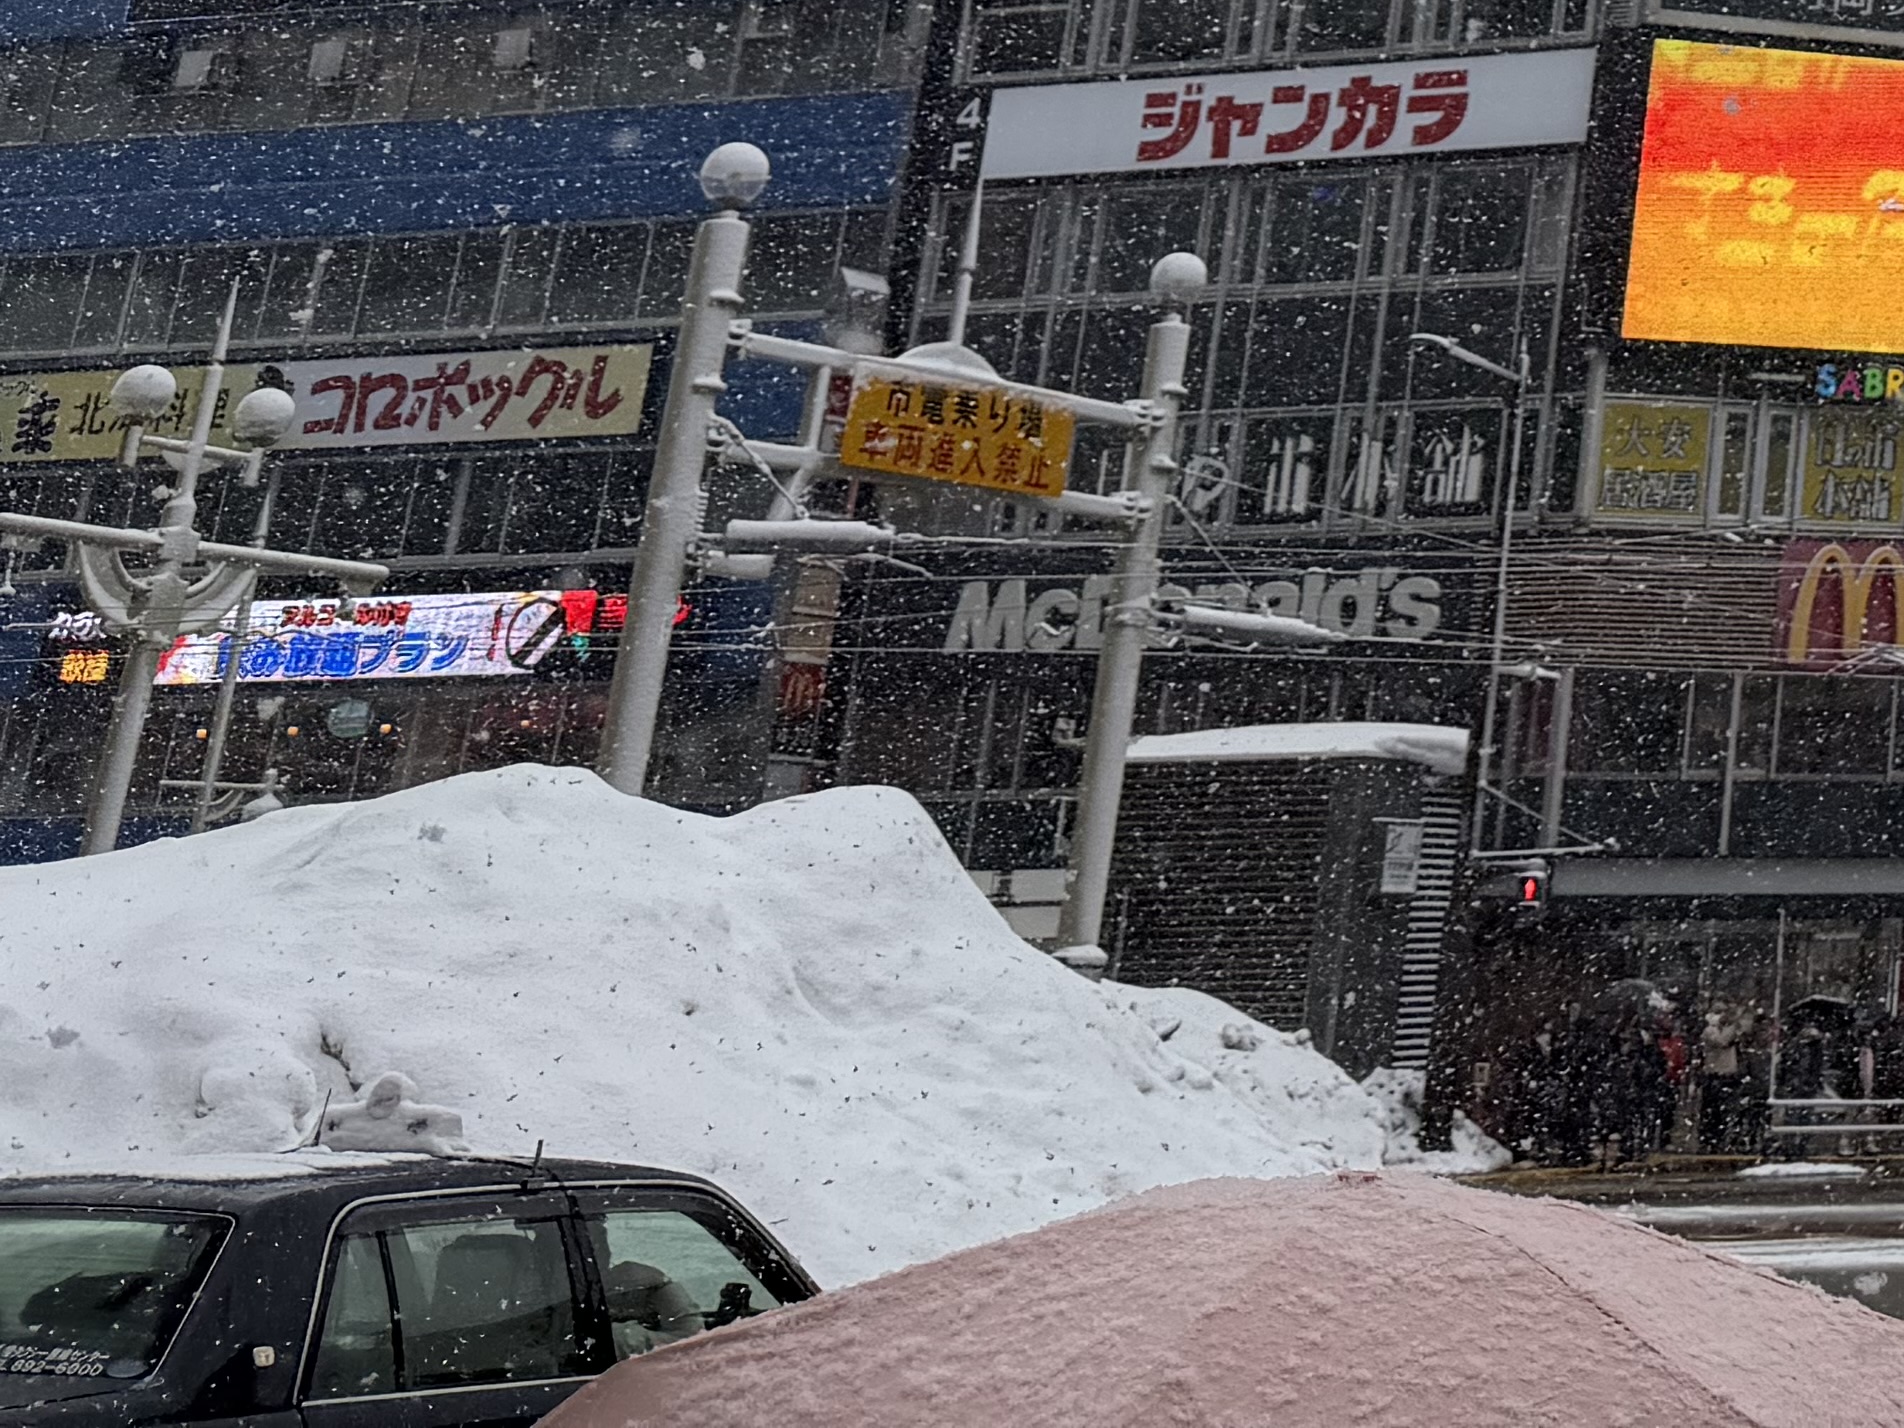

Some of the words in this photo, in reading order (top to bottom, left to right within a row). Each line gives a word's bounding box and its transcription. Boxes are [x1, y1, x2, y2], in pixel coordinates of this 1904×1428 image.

[1136, 69, 1469, 162] ジャンカラ
[887, 381, 1044, 440] 市電乗り場
[1615, 416, 1692, 459] 大安
[858, 419, 1050, 490] 車両進入禁止
